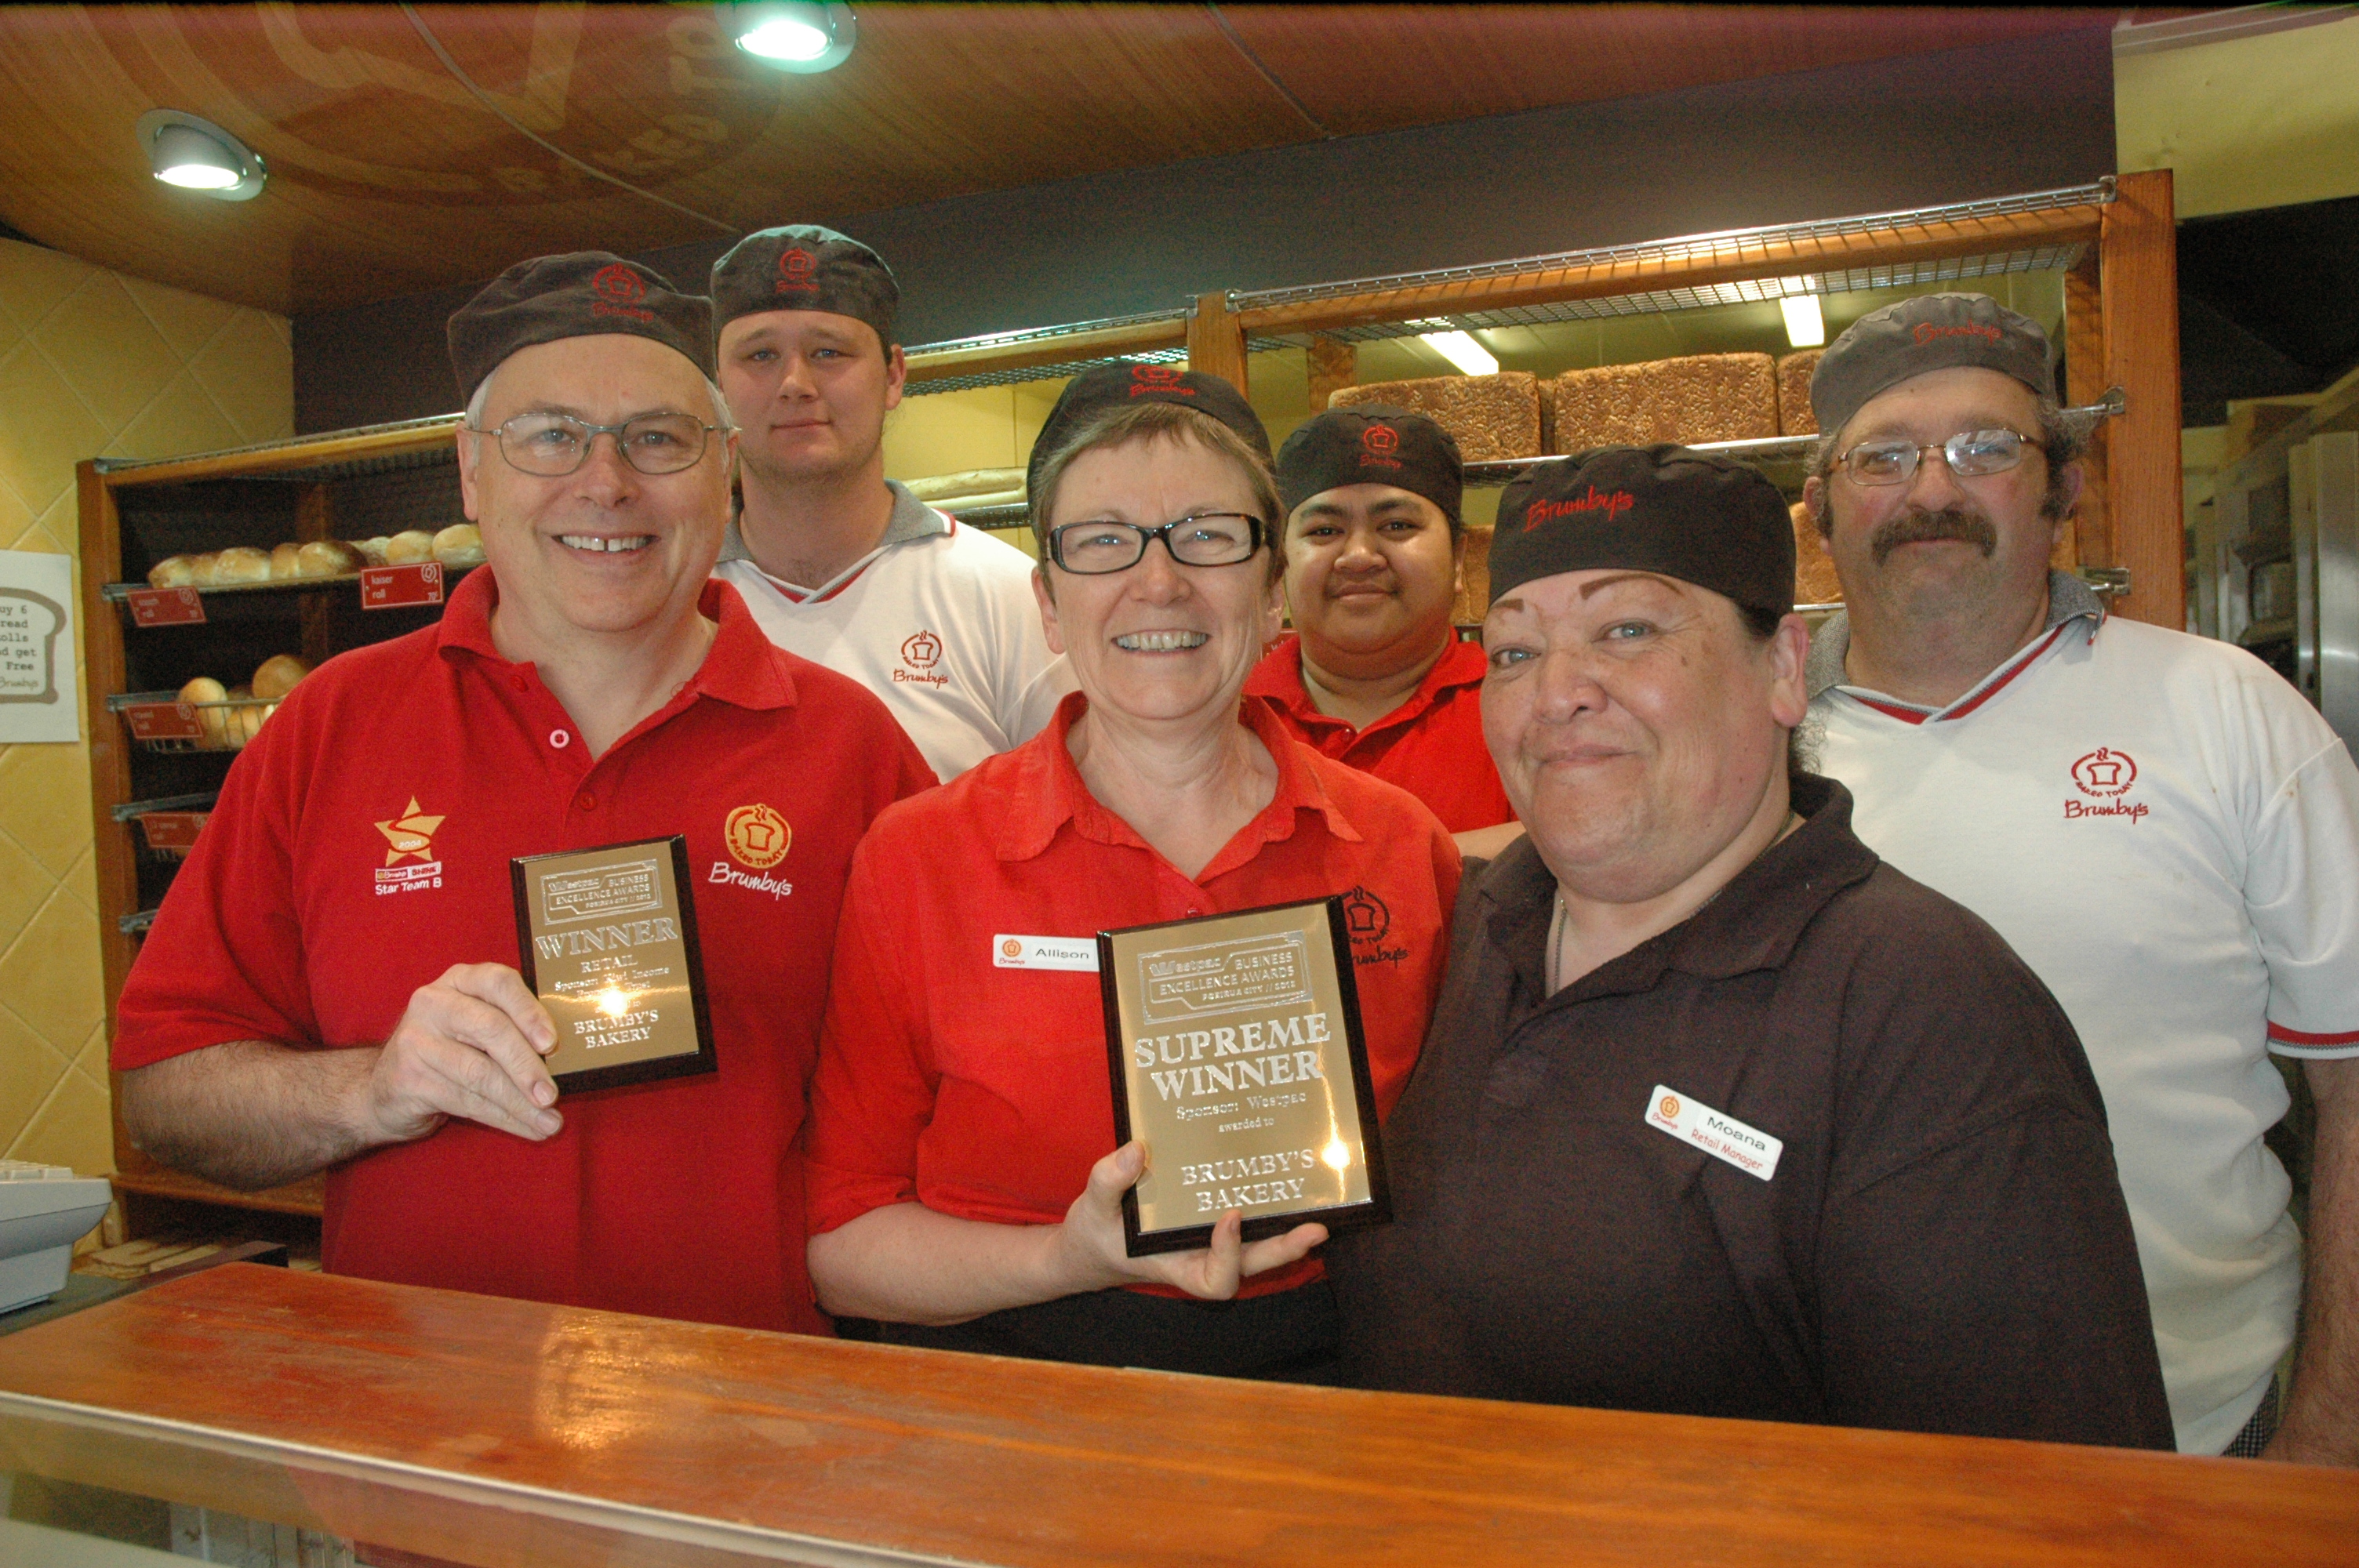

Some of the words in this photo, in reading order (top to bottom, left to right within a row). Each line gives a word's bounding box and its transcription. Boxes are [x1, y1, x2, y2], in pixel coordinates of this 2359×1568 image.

[1521, 485, 1634, 533] Brumby's
[0, 606, 13, 616] uy
[20, 604, 28, 614] 6
[0, 619, 29, 628] read
[0, 633, 29, 642] olls
[16, 648, 38, 659] get
[6, 661, 35, 670] Free
[2064, 797, 2149, 824] Brumby's
[375, 884, 399, 895] Star
[401, 880, 430, 891] Team
[433, 877, 442, 888] B
[609, 873, 649, 887] BUSINESS
[708, 862, 793, 901] Brumby's
[556, 889, 611, 905] EXCELLENCE
[613, 883, 650, 896] AWARDS
[536, 916, 678, 959] WINNER
[580, 954, 638, 973] RETAIL
[1035, 948, 1089, 960] Allison
[1150, 957, 1221, 977] Westpac
[1234, 952, 1293, 971] BUSINESS
[1352, 945, 1408, 968] rumby's
[632, 967, 670, 978] Income
[1160, 974, 1238, 996] EXCELLENCE
[1241, 965, 1295, 984] AWARDS
[1202, 988, 1242, 1001] PORIRUA
[1244, 984, 1263, 995] CITY
[574, 1010, 659, 1034] BRUMBY'S
[585, 1026, 651, 1048] BAKERY
[1134, 1012, 1332, 1068] SUPREME
[1150, 1050, 1325, 1101] WINNER
[1176, 1101, 1239, 1121] Sponsor:
[1246, 1092, 1307, 1110] Westpac
[1219, 1116, 1262, 1133] awarded
[1263, 1116, 1275, 1127] to
[1707, 1116, 1766, 1152] Moana
[1691, 1128, 1721, 1150] Retail
[1721, 1144, 1764, 1170] Manager
[1180, 1149, 1316, 1185] BRUMBY'S
[1196, 1178, 1306, 1212] BAKERY
